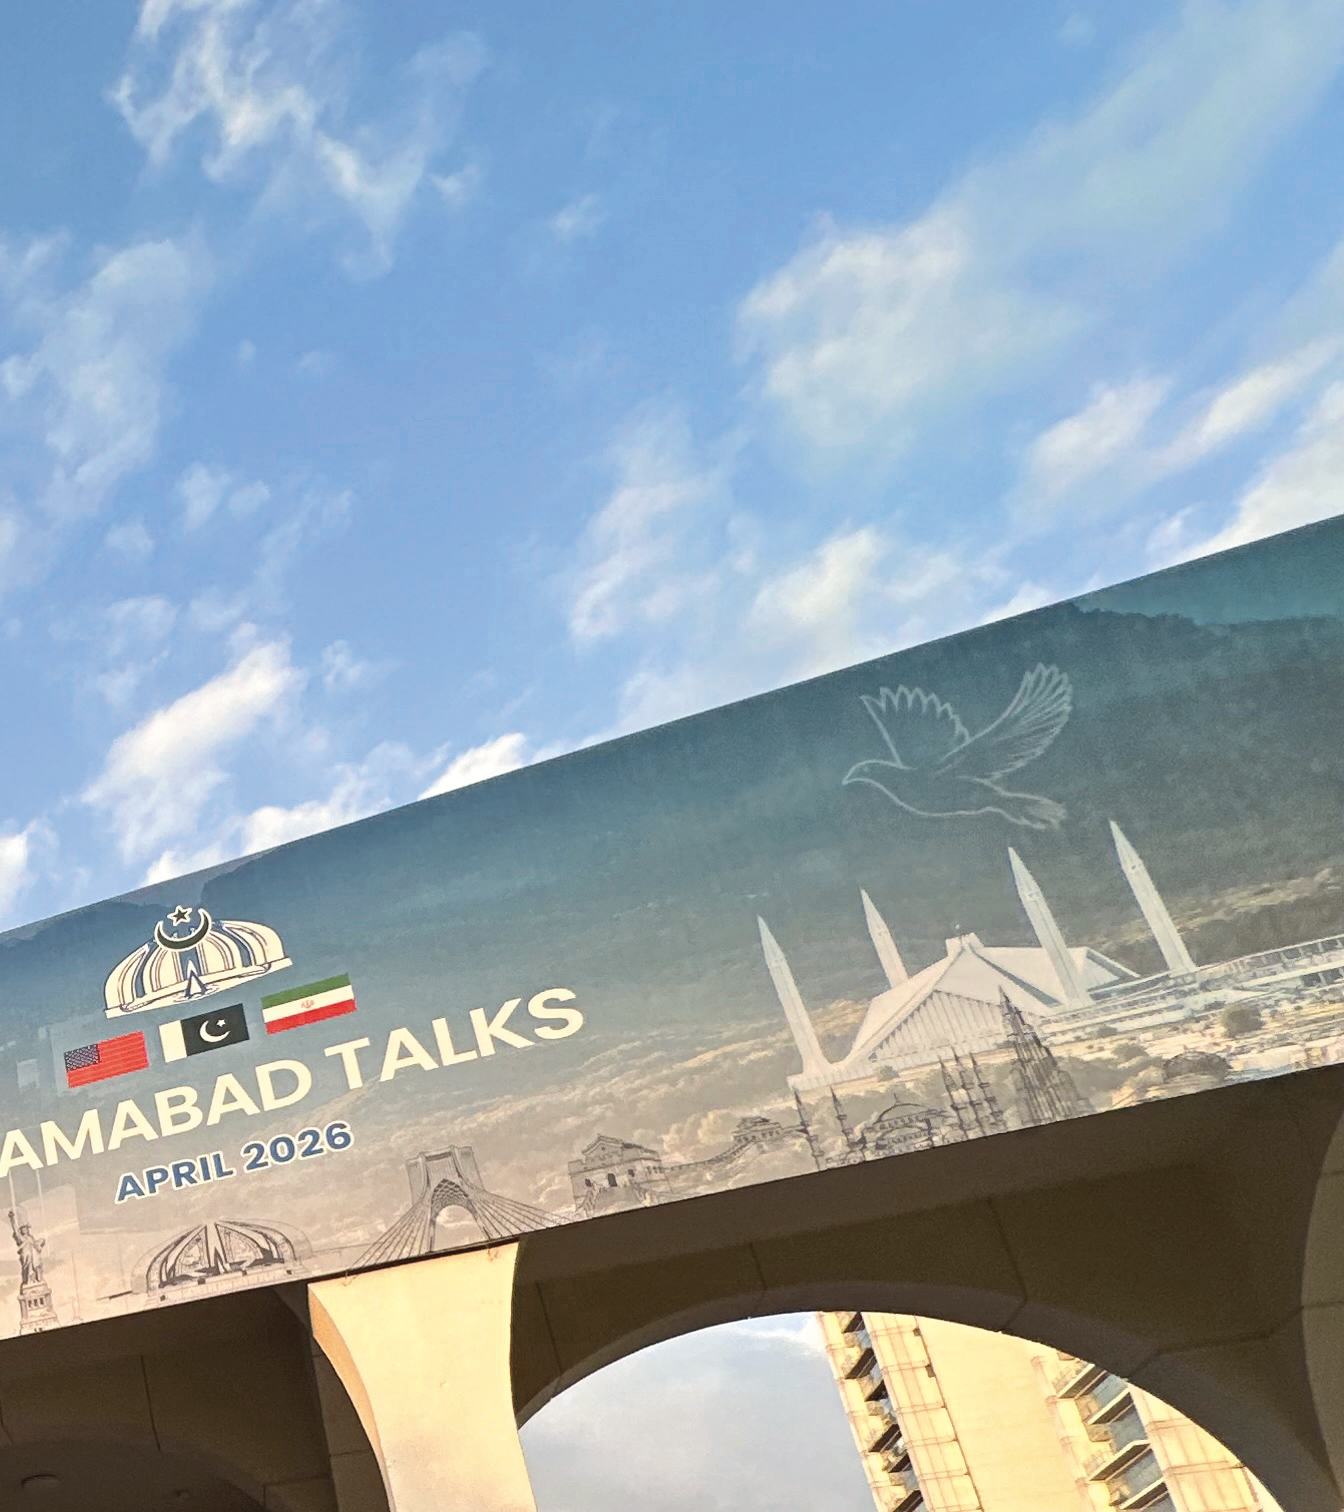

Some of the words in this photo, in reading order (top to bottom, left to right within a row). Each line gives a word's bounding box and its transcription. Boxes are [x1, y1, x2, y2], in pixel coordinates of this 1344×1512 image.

[325, 987, 585, 1092] TALKS
[114, 1152, 235, 1205] APRIL
[244, 1121, 353, 1174] 2026
